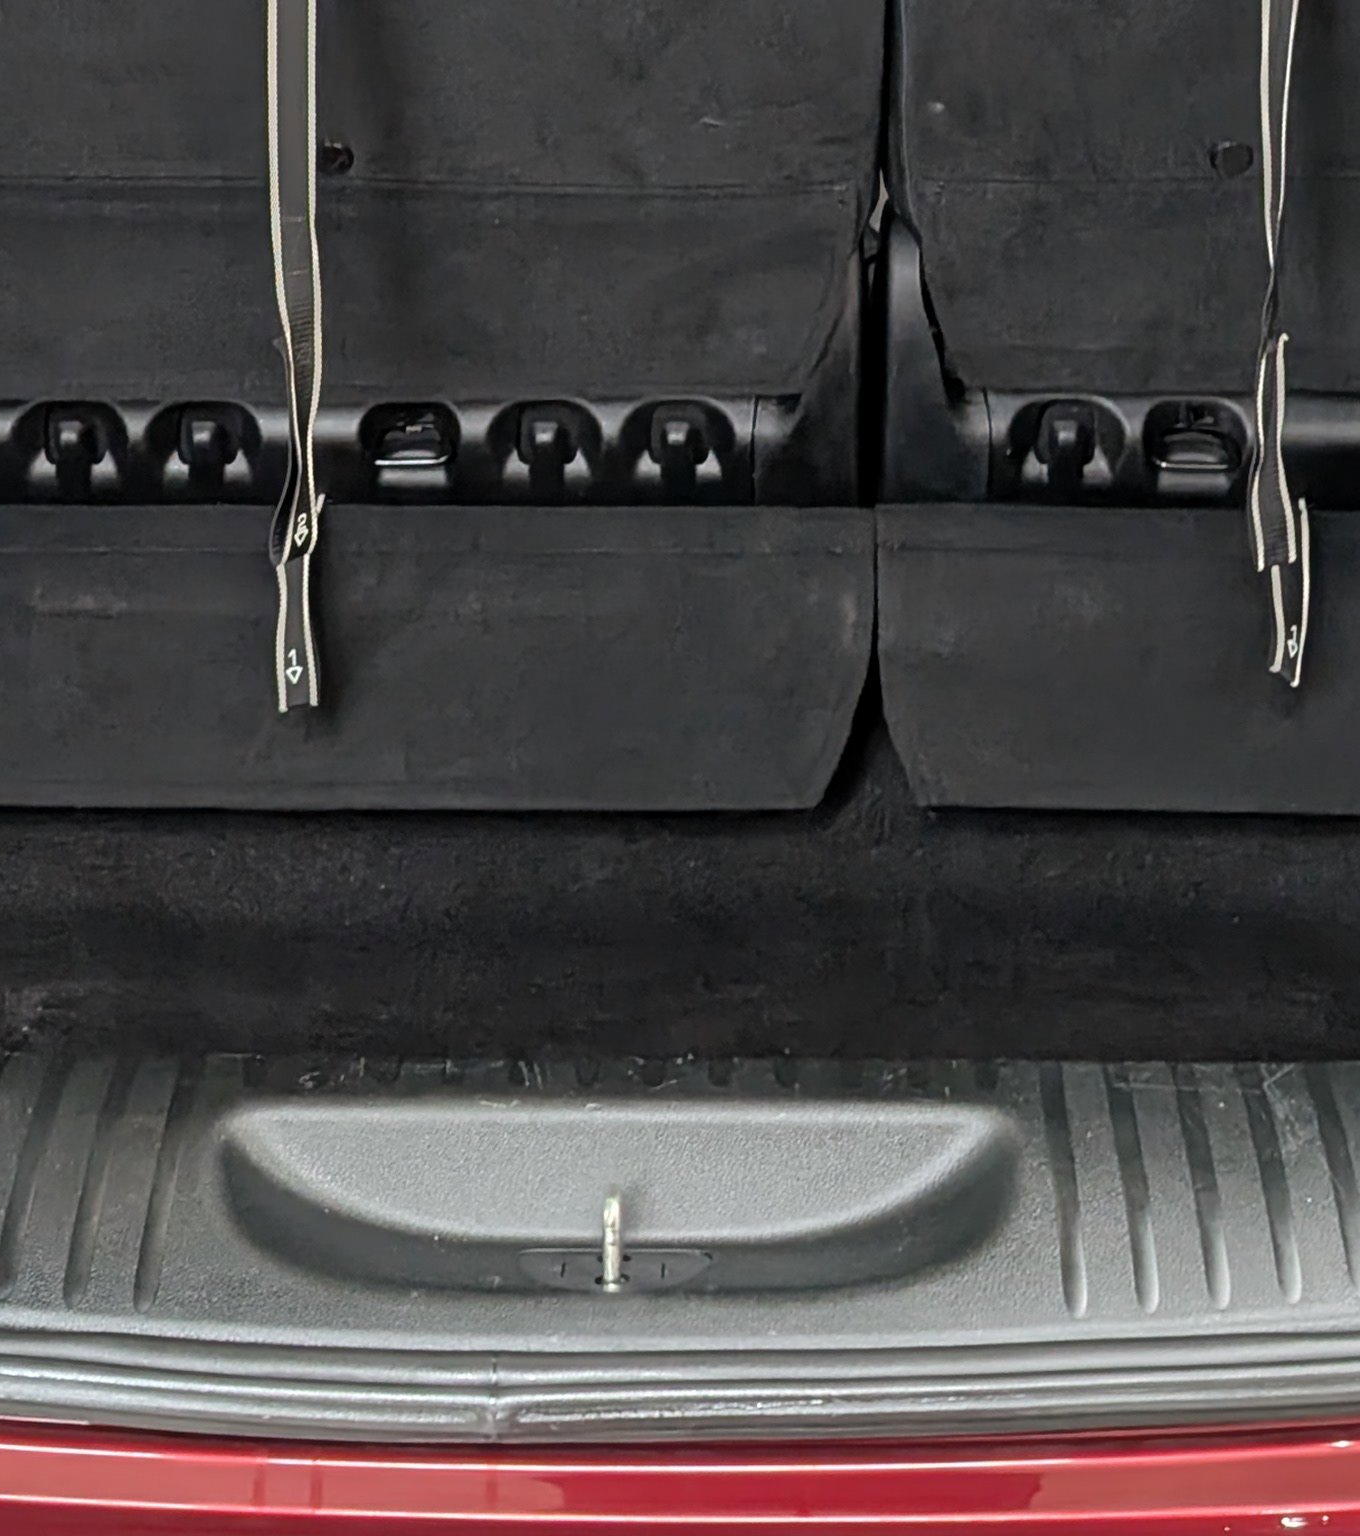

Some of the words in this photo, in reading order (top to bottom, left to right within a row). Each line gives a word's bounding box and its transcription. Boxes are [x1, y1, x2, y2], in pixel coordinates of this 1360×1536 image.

[297, 512, 307, 532] 2
[1290, 625, 1298, 642] 1
[288, 648, 297, 666] 1
